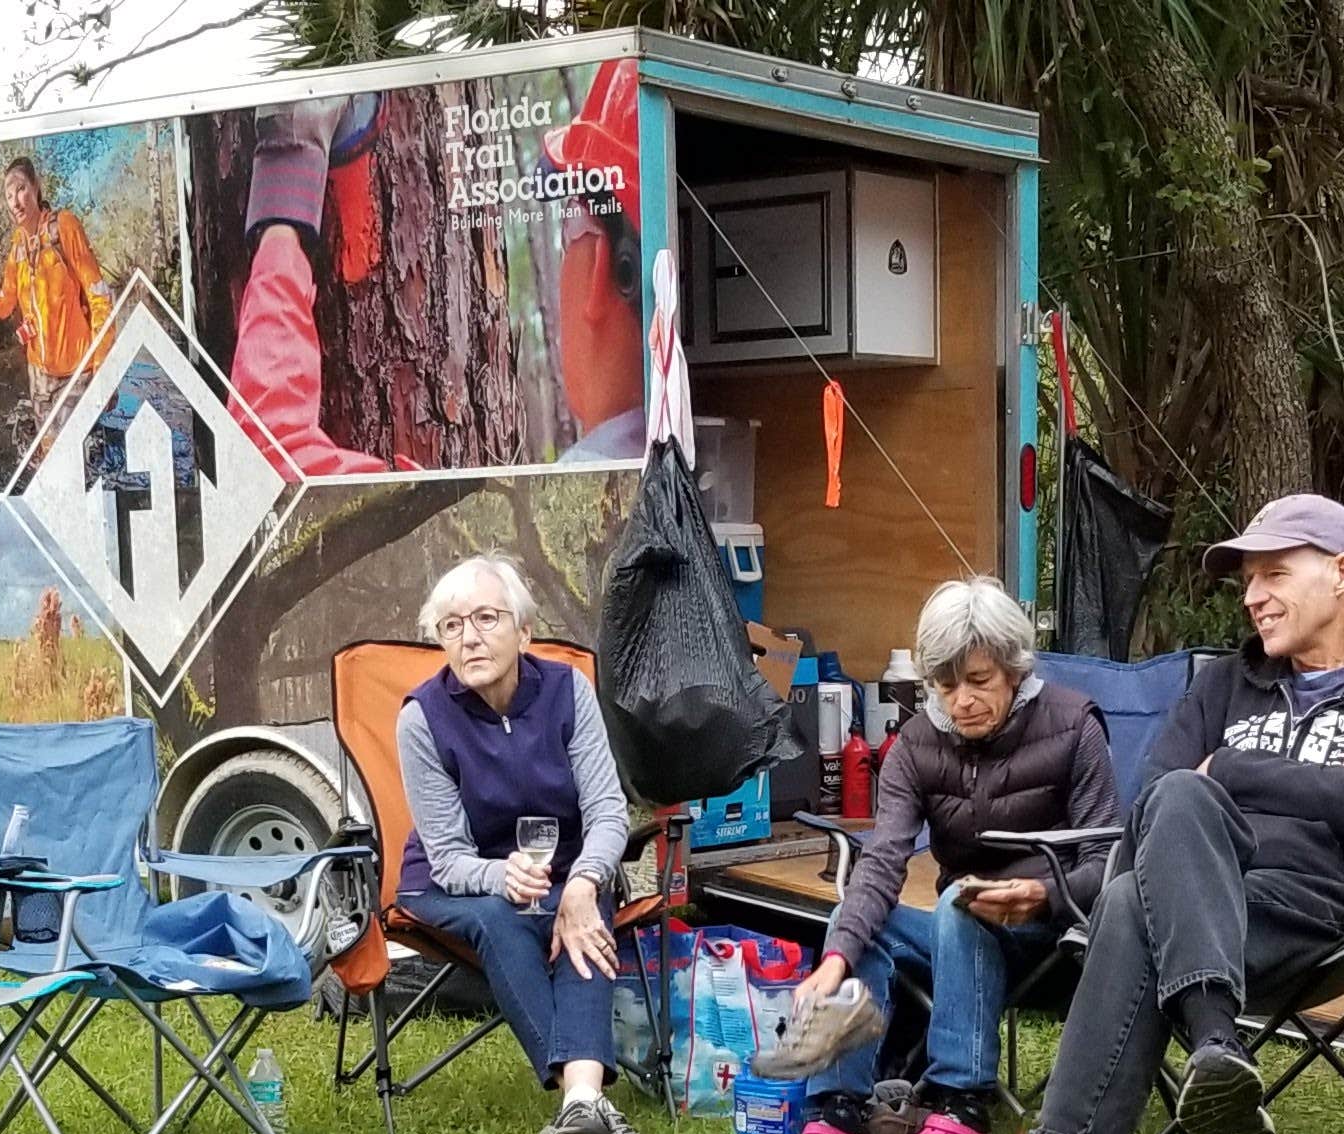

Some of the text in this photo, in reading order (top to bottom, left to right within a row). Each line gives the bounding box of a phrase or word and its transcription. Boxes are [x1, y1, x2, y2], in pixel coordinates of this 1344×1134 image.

[444, 96, 552, 137] Florida
[445, 135, 515, 173] Trail
[447, 162, 626, 209] Association
[451, 196, 623, 231] Building More Than Trails
